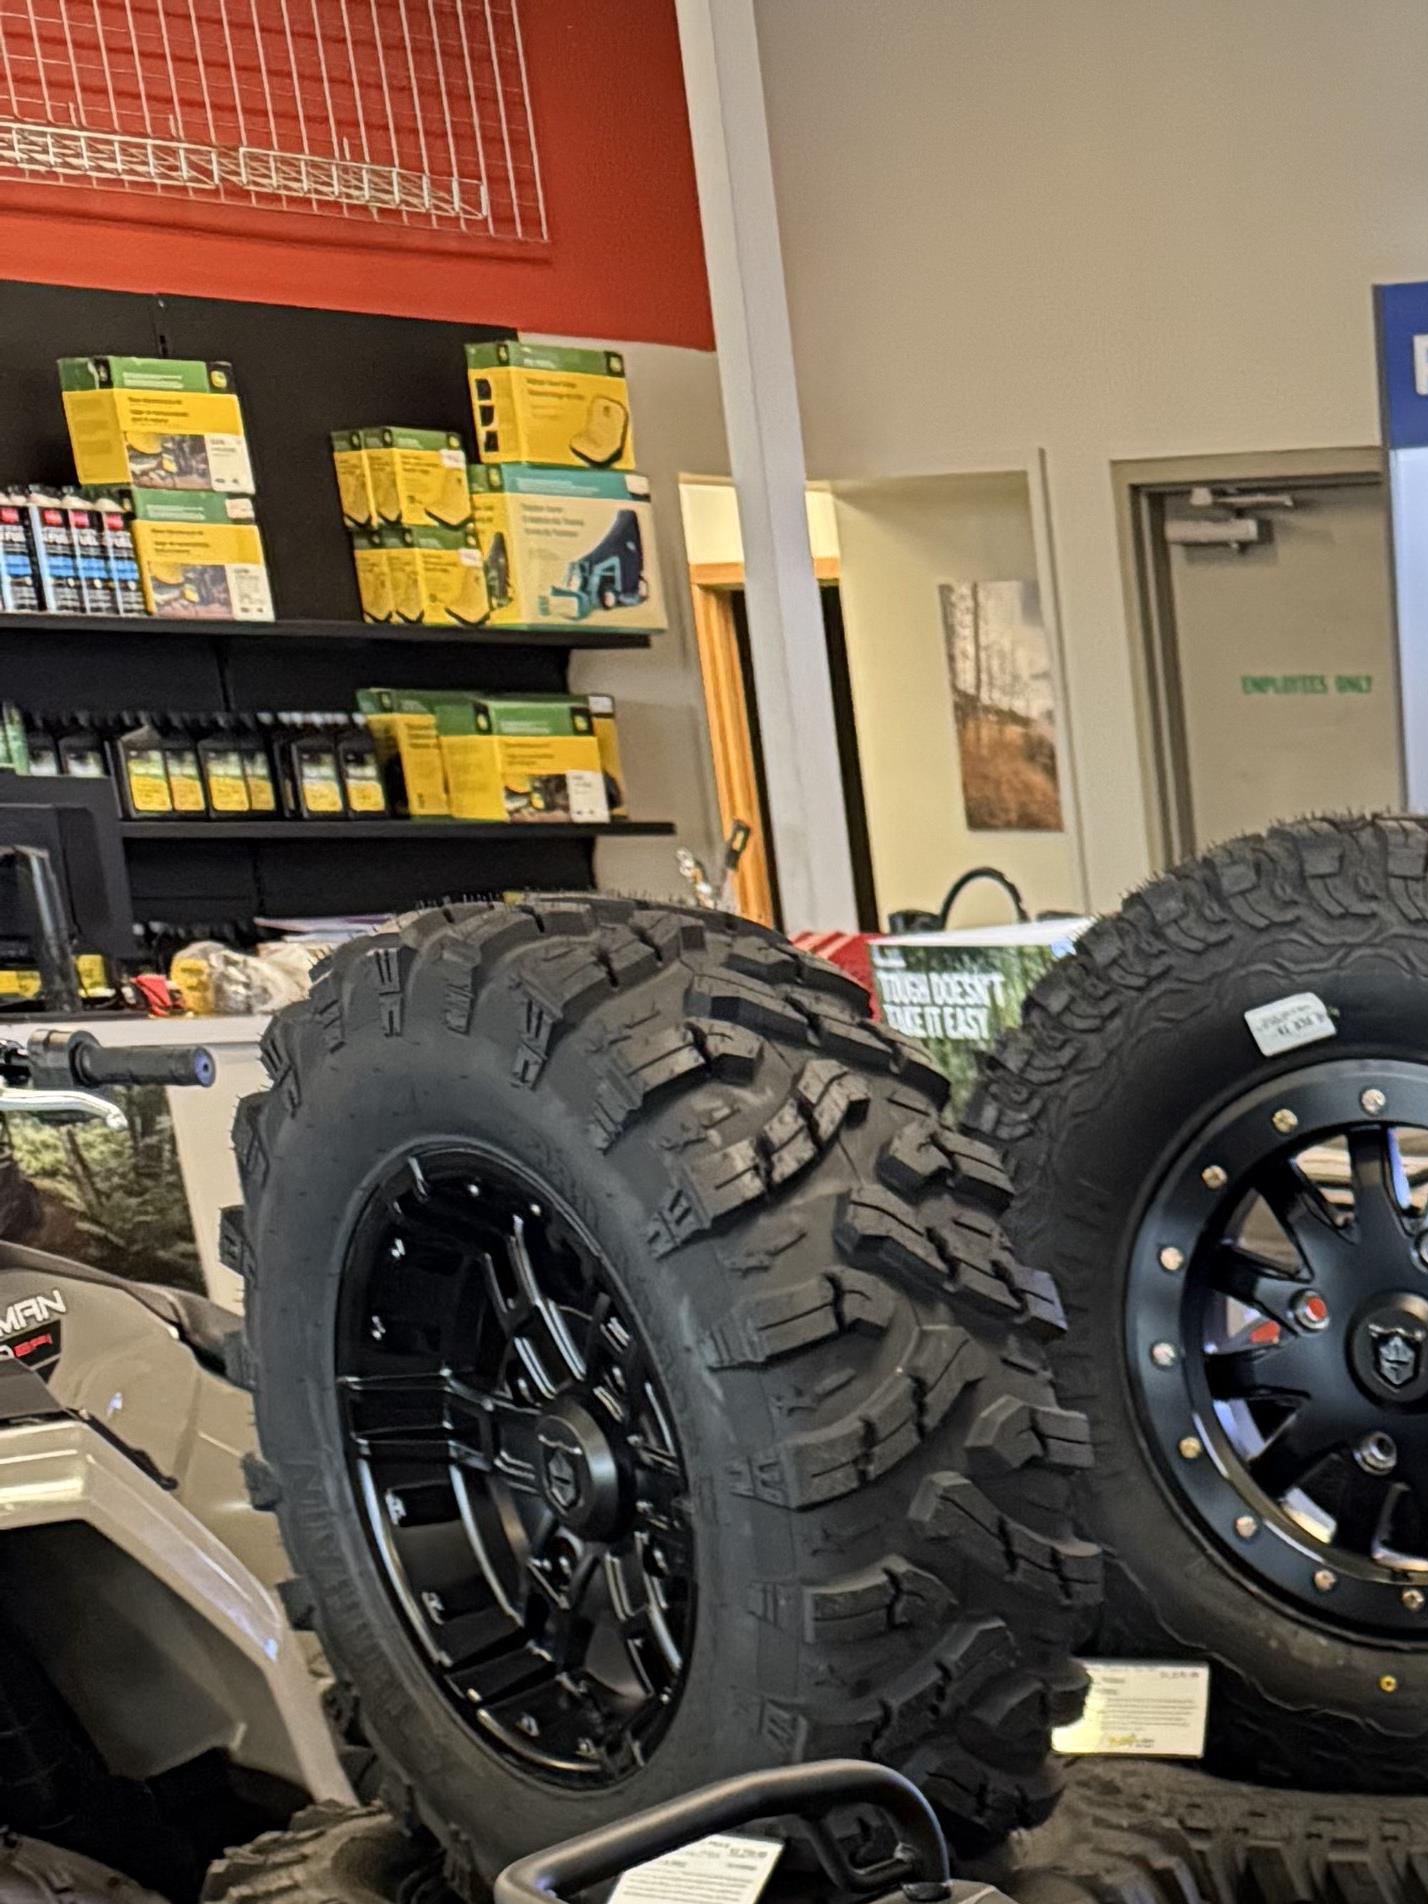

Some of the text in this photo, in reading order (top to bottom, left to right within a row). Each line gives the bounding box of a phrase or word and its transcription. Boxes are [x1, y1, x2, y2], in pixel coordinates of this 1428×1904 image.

[1241, 675, 1373, 695] EMPLOYEES ONLY
[928, 971, 1005, 1008] DOESN'T
[923, 1005, 945, 1039] IT
[943, 1006, 990, 1040] EASY
